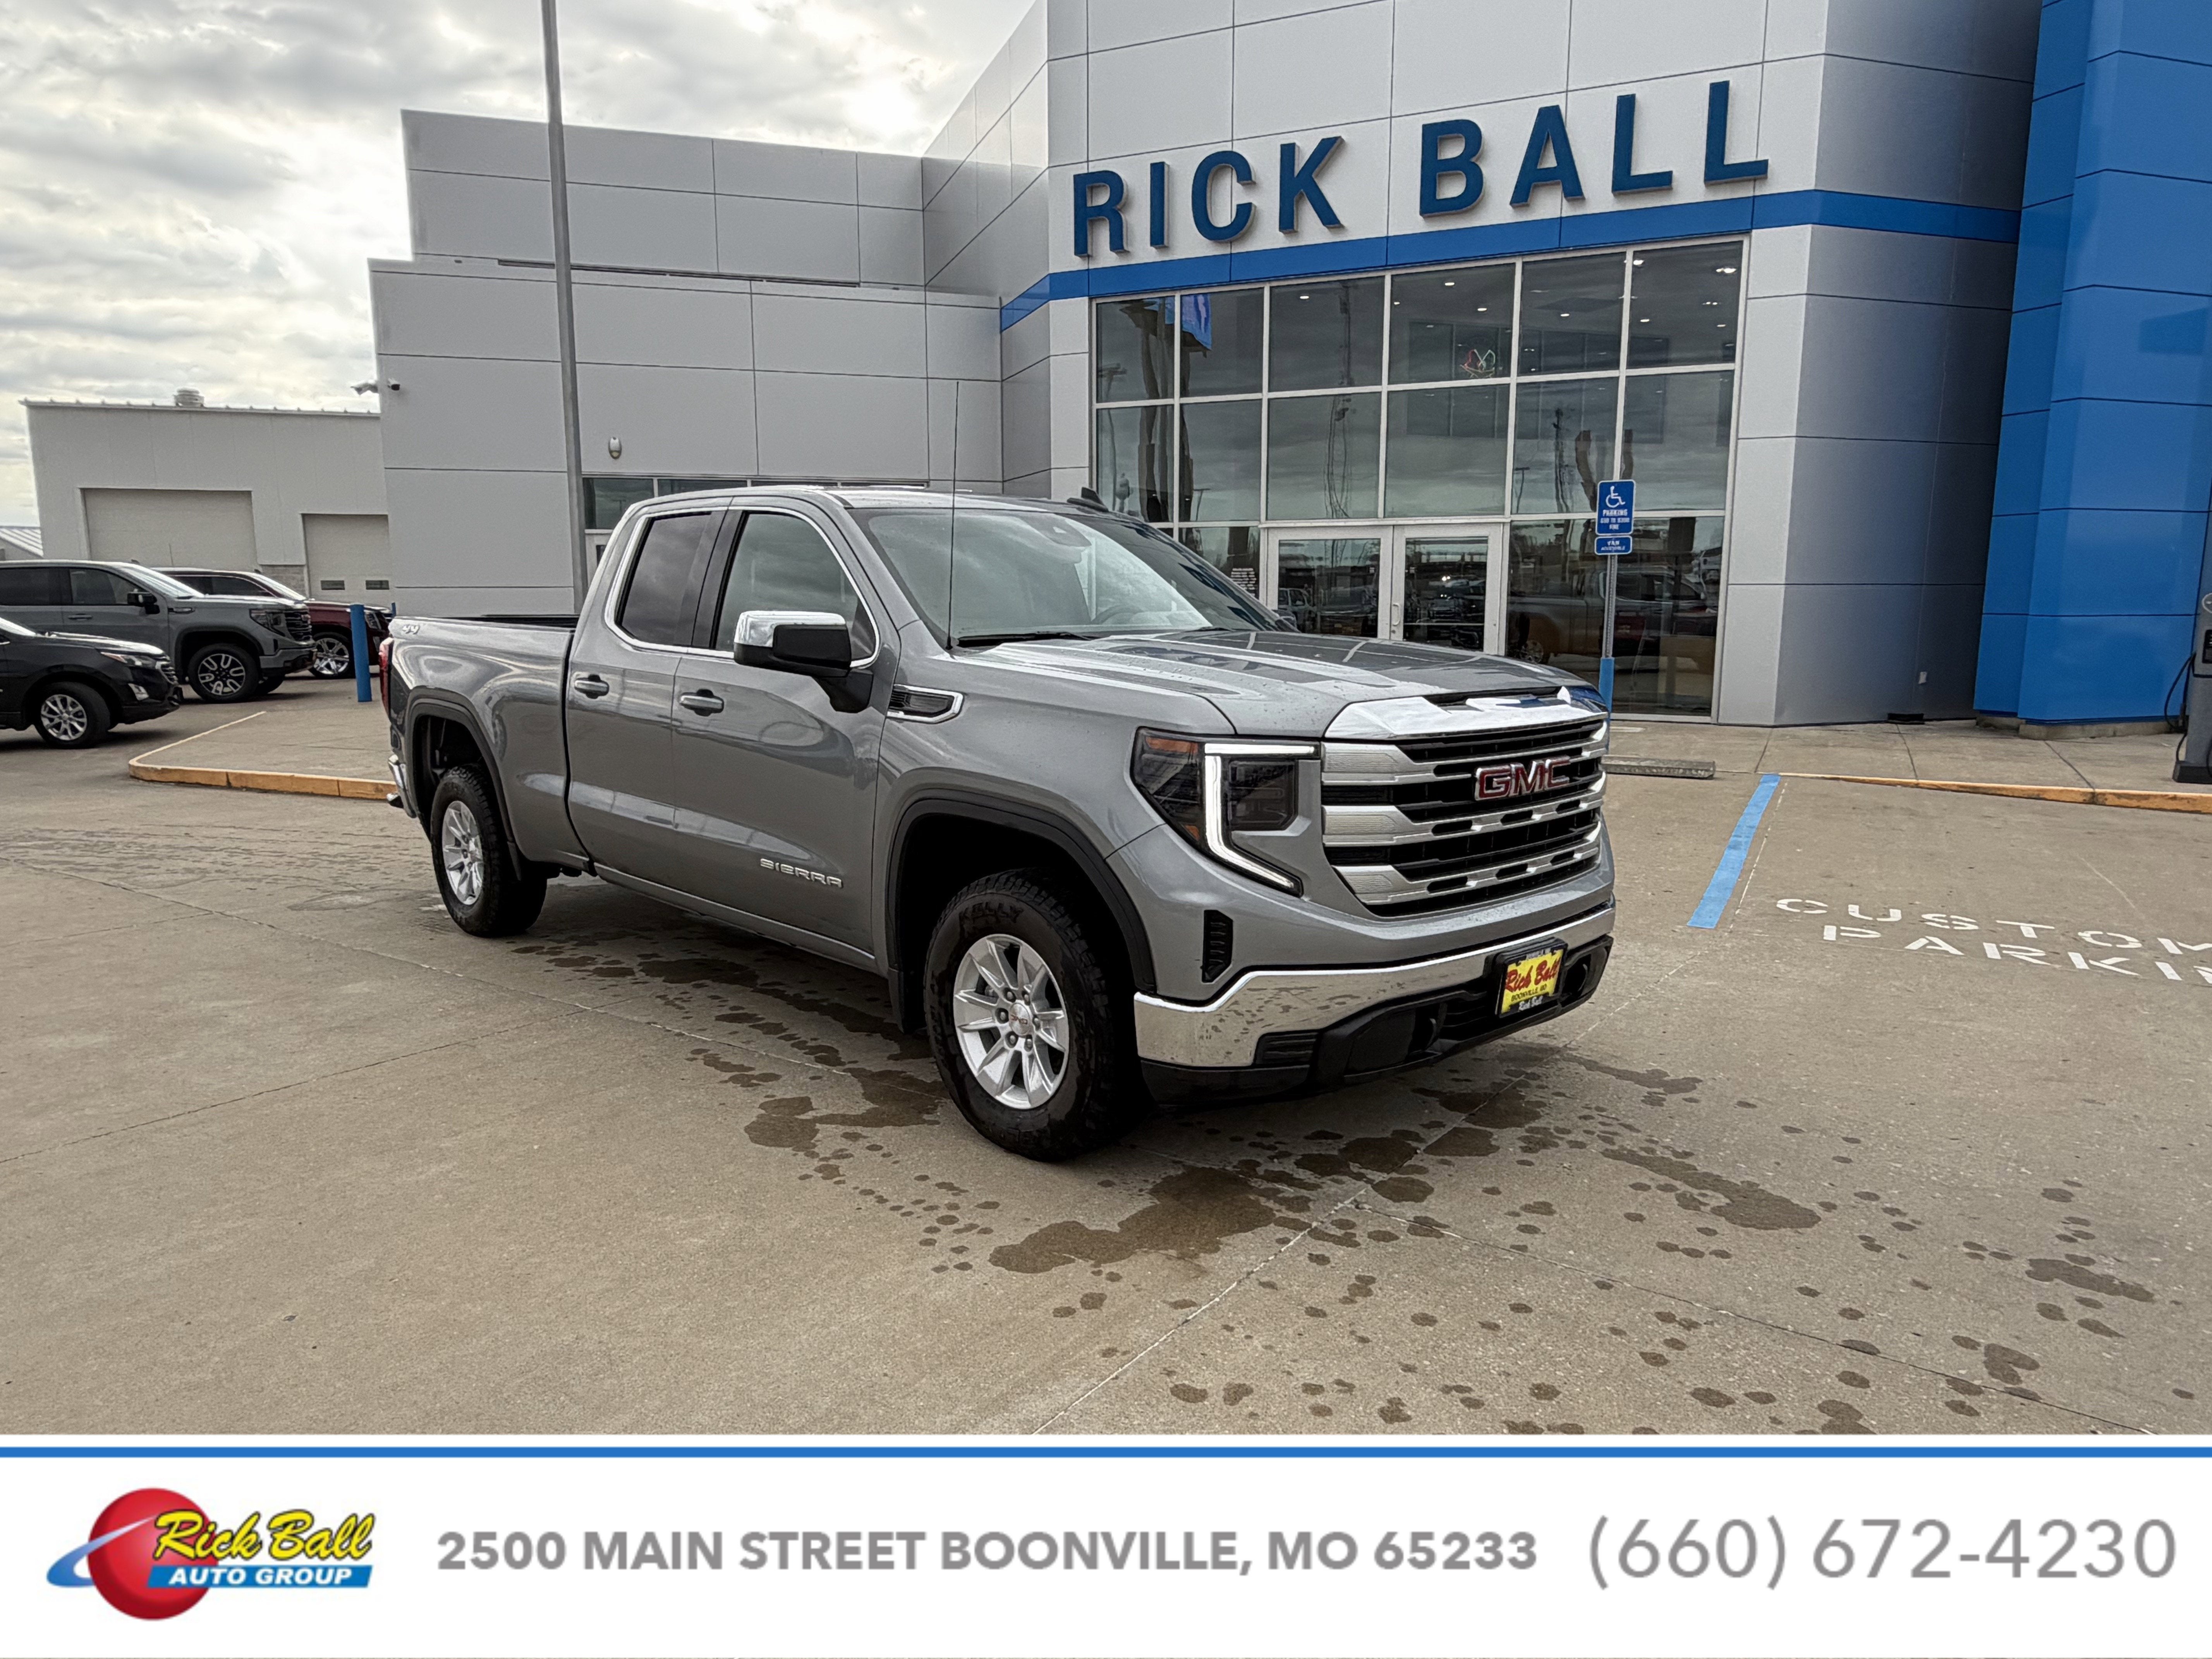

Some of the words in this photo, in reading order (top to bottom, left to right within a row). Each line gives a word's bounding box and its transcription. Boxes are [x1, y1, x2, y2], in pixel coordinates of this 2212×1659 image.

[1073, 135, 1344, 257] RICK
[1419, 81, 1769, 218] BALL
[1475, 755, 1570, 801] GMC
[760, 858, 843, 888] SIERRA
[959, 902, 1024, 924] KELLY
[1776, 898, 2212, 954] CUSTOM
[1506, 965, 1534, 993] Rick
[1535, 958, 1561, 985] Ball
